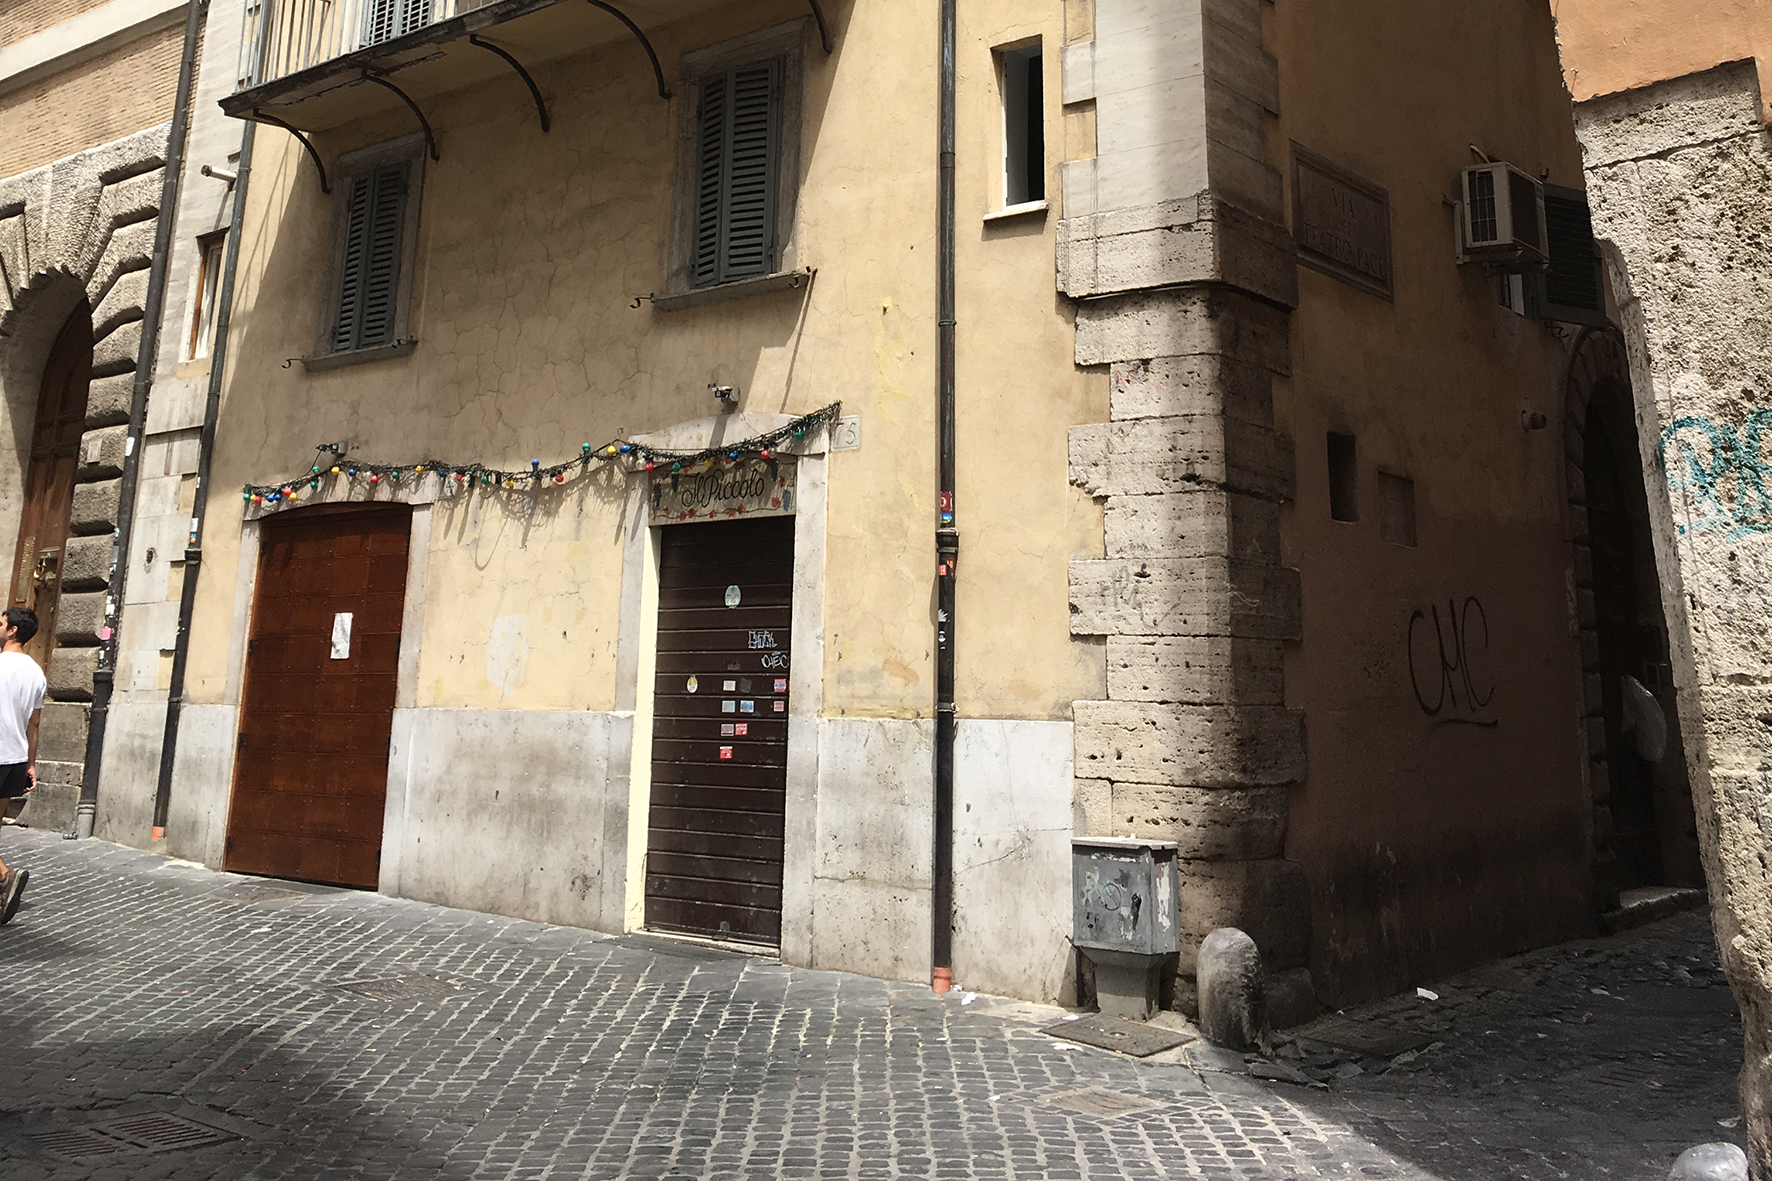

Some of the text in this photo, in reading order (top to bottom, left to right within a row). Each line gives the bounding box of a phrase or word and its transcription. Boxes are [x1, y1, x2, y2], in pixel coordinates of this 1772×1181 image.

[1331, 187, 1356, 220] VIA
[1333, 216, 1354, 238] DEL
[1302, 219, 1385, 279] TEATRO PACE
[701, 468, 765, 508] Piccolo
